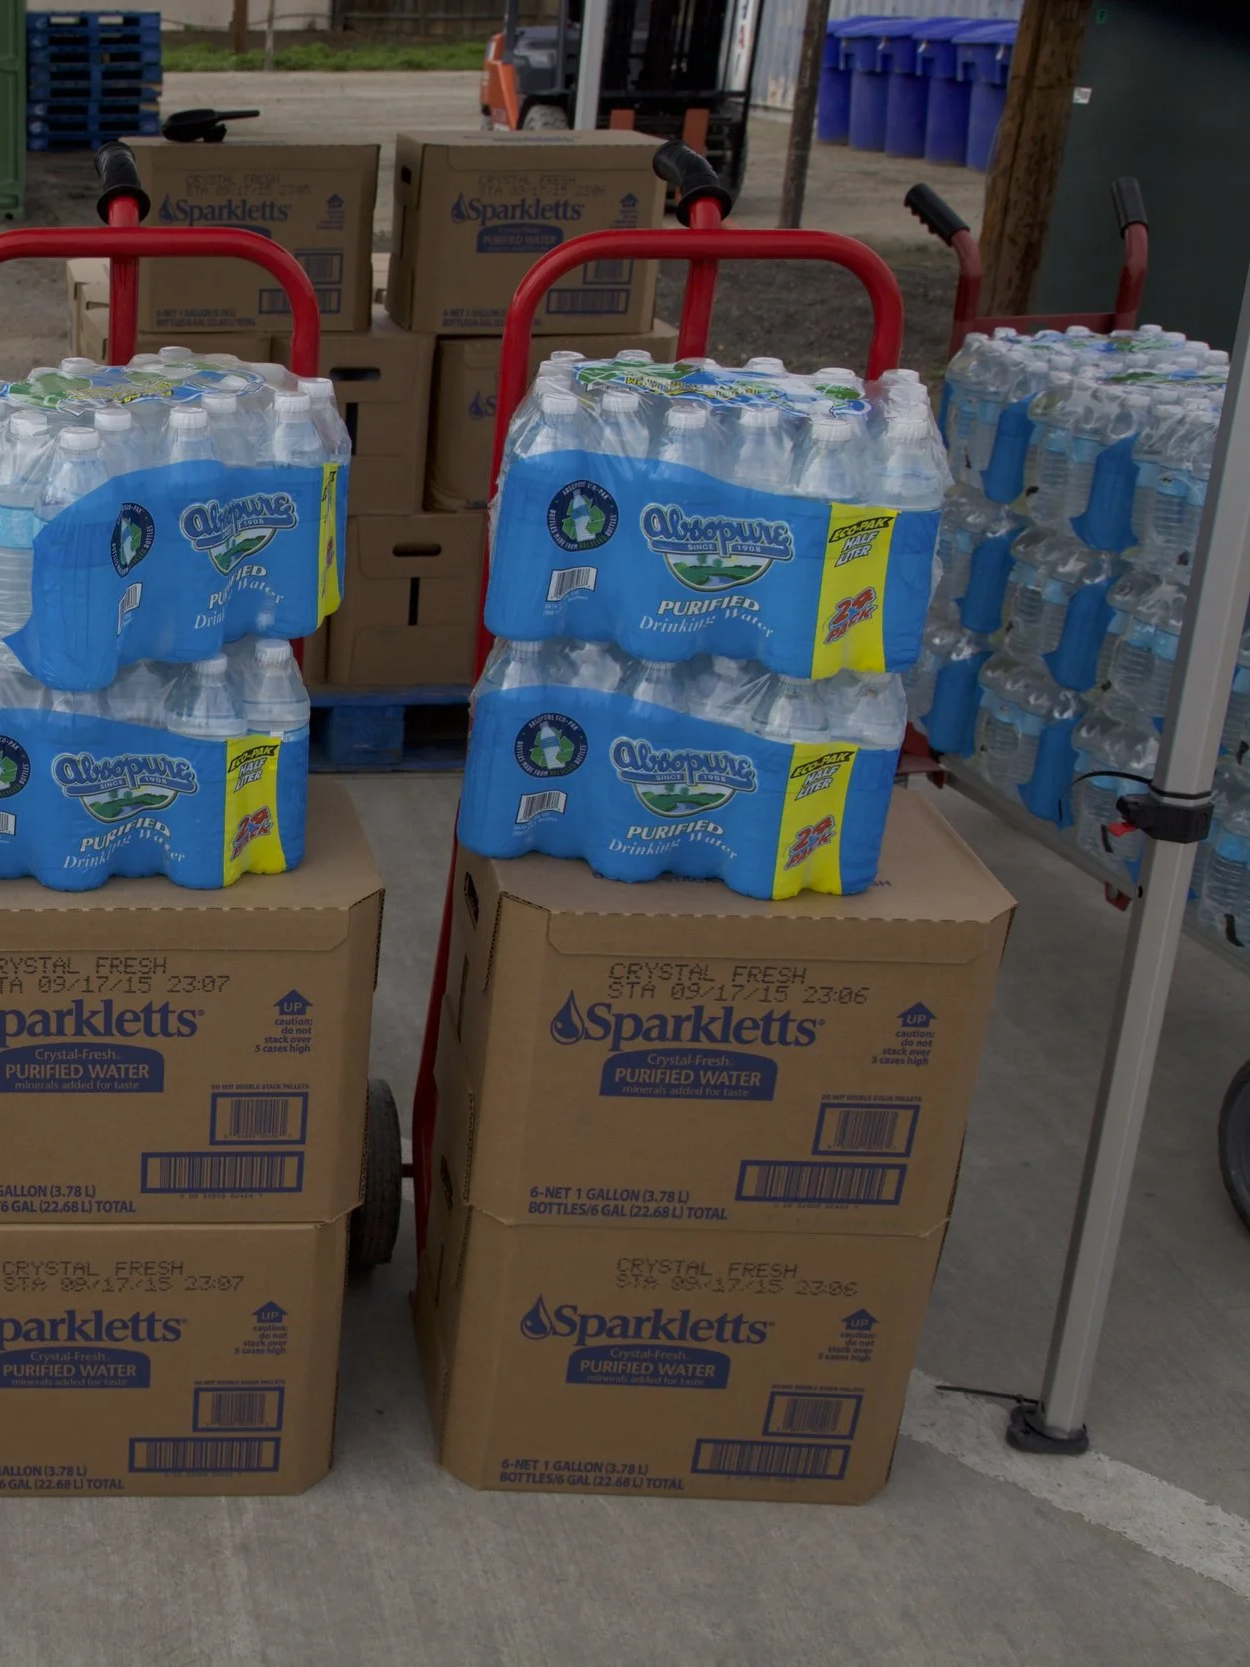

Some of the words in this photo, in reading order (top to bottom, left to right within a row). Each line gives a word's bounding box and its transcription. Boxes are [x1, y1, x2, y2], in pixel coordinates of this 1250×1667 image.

[175, 199, 289, 226] Sparkletts
[468, 198, 582, 227] Sparkletts
[830, 517, 893, 542] ECO-PAK
[687, 542, 714, 551] SINCE
[737, 543, 762, 553] 1908
[843, 531, 877, 552] HALF
[834, 544, 871, 567] LITER
[658, 595, 760, 616] PURIFIED
[830, 587, 877, 628] 24
[638, 614, 715, 634] Drinking
[824, 605, 878, 645] PACK
[228, 744, 278, 773] ECO-PAK
[239, 758, 266, 775] HALF
[790, 751, 855, 778] ECO-PAK
[99, 780, 123, 790] SINCE
[144, 776, 167, 785] 1908
[234, 770, 263, 792] LITER
[656, 774, 681, 783] SINCE
[703, 774, 726, 783] 1908
[804, 766, 838, 788] HALF
[795, 776, 832, 801] LITER
[79, 817, 171, 853] PURIFIED
[626, 819, 724, 840] PURIFIED
[608, 837, 681, 857] Drinking
[95, 957, 167, 975] FRESH
[608, 963, 714, 982] CRYSTAL
[731, 965, 807, 985] FRESH
[284, 1001, 302, 1013] UP
[275, 1018, 313, 1026] caution:
[281, 1026, 292, 1035] do
[295, 1027, 311, 1035] not
[584, 1002, 818, 1051] Sparkletts
[255, 1044, 260, 1053] 5
[286, 1044, 310, 1055] high
[264, 1035, 287, 1044] stack
[5, 1064, 83, 1079] PURIFIED
[88, 1064, 149, 1079] WATER
[614, 1068, 694, 1086] PURIFIED
[699, 1070, 761, 1087] WATER
[15, 1079, 58, 1091] minerals
[60, 1079, 93, 1090] added
[95, 1079, 112, 1091] for
[114, 1081, 139, 1090] taste
[10, 1199, 36, 1213] GAL
[95, 1199, 136, 1213] TOTAL
[3, 1261, 98, 1276] CRYSTAL
[115, 1261, 184, 1275] FRESH
[617, 1258, 711, 1276] CRYSTAL
[728, 1262, 798, 1279] FRESH
[551, 1304, 767, 1346] Sparkletts
[3, 1363, 74, 1377] PURIFIED
[80, 1363, 136, 1377] WATER
[580, 1359, 654, 1375] PURIFIED
[659, 1362, 716, 1377] WATER
